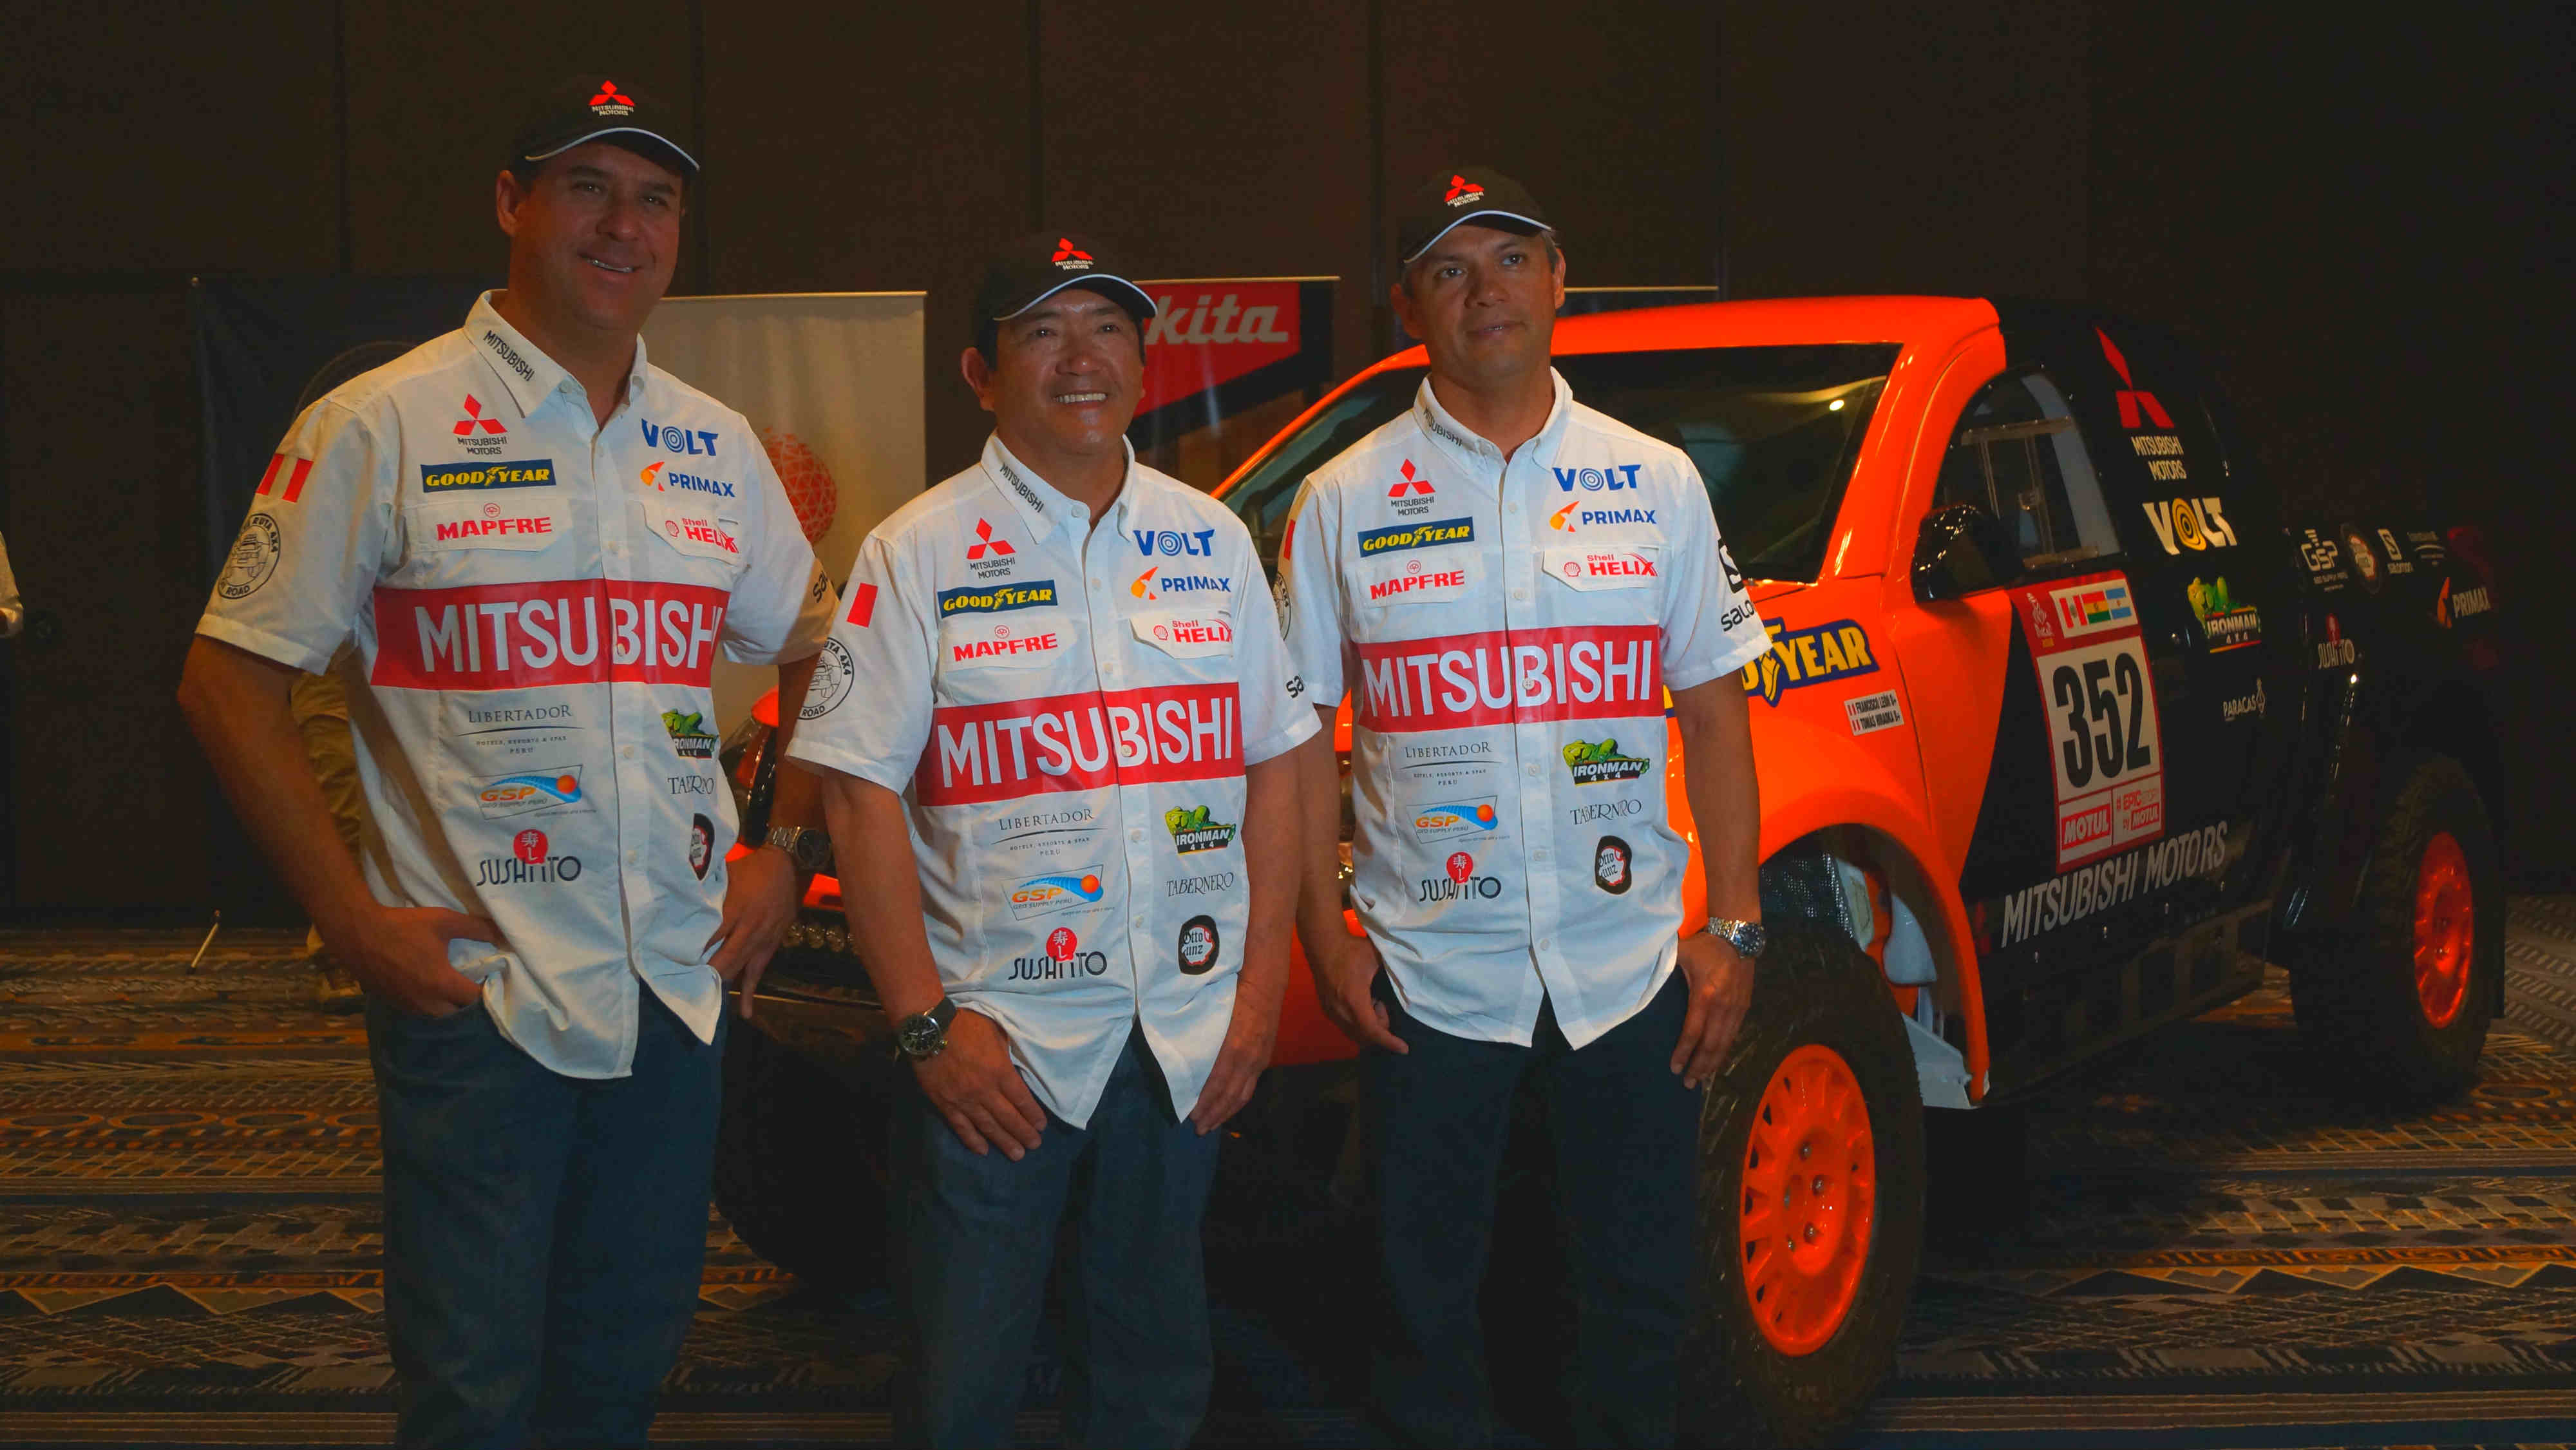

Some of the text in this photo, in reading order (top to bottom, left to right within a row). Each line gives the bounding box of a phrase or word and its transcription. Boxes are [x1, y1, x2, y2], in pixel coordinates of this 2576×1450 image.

[1145, 294, 1288, 345] kita
[483, 330, 535, 381] MITSUBISHI
[457, 436, 507, 446] MITSUBISHI
[641, 419, 718, 455] VOLT
[2131, 436, 2184, 456] MITSUBISHI
[467, 446, 502, 455] MOTORS
[1552, 464, 1642, 491] VOLT
[2148, 460, 2187, 481] MOTORS
[668, 472, 735, 497] PRIMAX
[999, 463, 1044, 513] MITSUBISHI
[1390, 496, 1434, 507] MITSUBISHI
[1397, 506, 1429, 516] MOTORS
[437, 517, 552, 540] MAPFRE
[682, 518, 708, 527] Shell
[1582, 509, 1657, 525] PRIMAX
[2143, 496, 2237, 556] VOLT
[684, 526, 739, 553] HELIX
[1133, 529, 1215, 557] VOLT
[1363, 526, 1470, 551] GOODYEAR
[970, 557, 1016, 569] MITSUBISHI
[978, 568, 1010, 578] MOTORS
[1587, 558, 1658, 577] HELIX
[1160, 576, 1231, 593] PRIMAX
[1370, 570, 1464, 600] MAPFRE
[943, 589, 1053, 611] GOODYEAR
[2452, 587, 2491, 618] PRIMAX
[1721, 599, 1755, 632] salo
[2206, 613, 2258, 638] IRONMAN
[414, 596, 723, 672] MITSUBISHI
[953, 633, 1058, 662] MAPFRE
[1363, 640, 1653, 717] MITSUBISHI
[468, 704, 573, 723] LIBERTADOR
[802, 706, 826, 717] ROAD
[2222, 694, 2257, 717] PARACAS
[2052, 653, 2151, 788] 352
[938, 697, 1233, 788] MITSUBISHI
[1405, 741, 1492, 758] LIBERTADOR
[1574, 760, 1643, 777] IRONMAN
[480, 787, 536, 802] GSP
[999, 808, 1094, 830] LIBERTADOR
[1416, 816, 1460, 828] GSP
[2063, 808, 2112, 846] MOTUL
[1176, 829, 1230, 845] IRONMAN
[1012, 888, 1063, 902] GSP
[1166, 872, 1234, 897] TABERNERO
[2001, 821, 2229, 949] MITSUBISHI MOTORS
